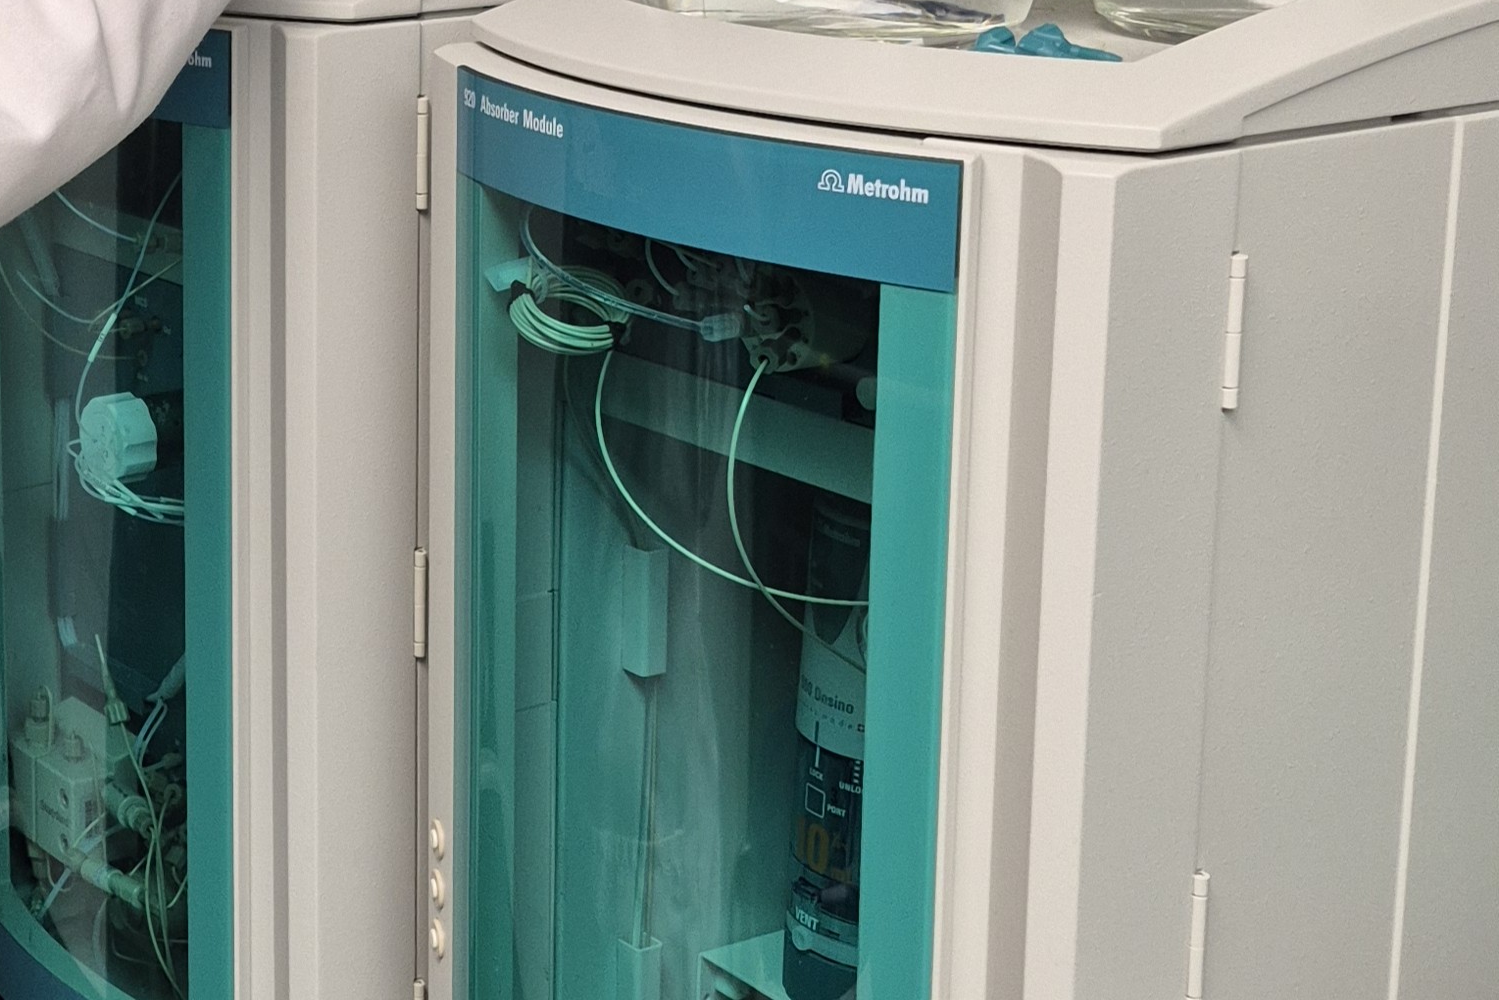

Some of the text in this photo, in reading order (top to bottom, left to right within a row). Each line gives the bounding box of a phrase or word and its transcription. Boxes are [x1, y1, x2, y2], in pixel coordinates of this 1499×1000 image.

[187, 49, 213, 69] ohm
[480, 95, 520, 126] Absorber
[523, 108, 564, 139] Module
[846, 172, 930, 204] Metrohm
[838, 781, 862, 795] UNLO
[795, 905, 820, 932] VENT
